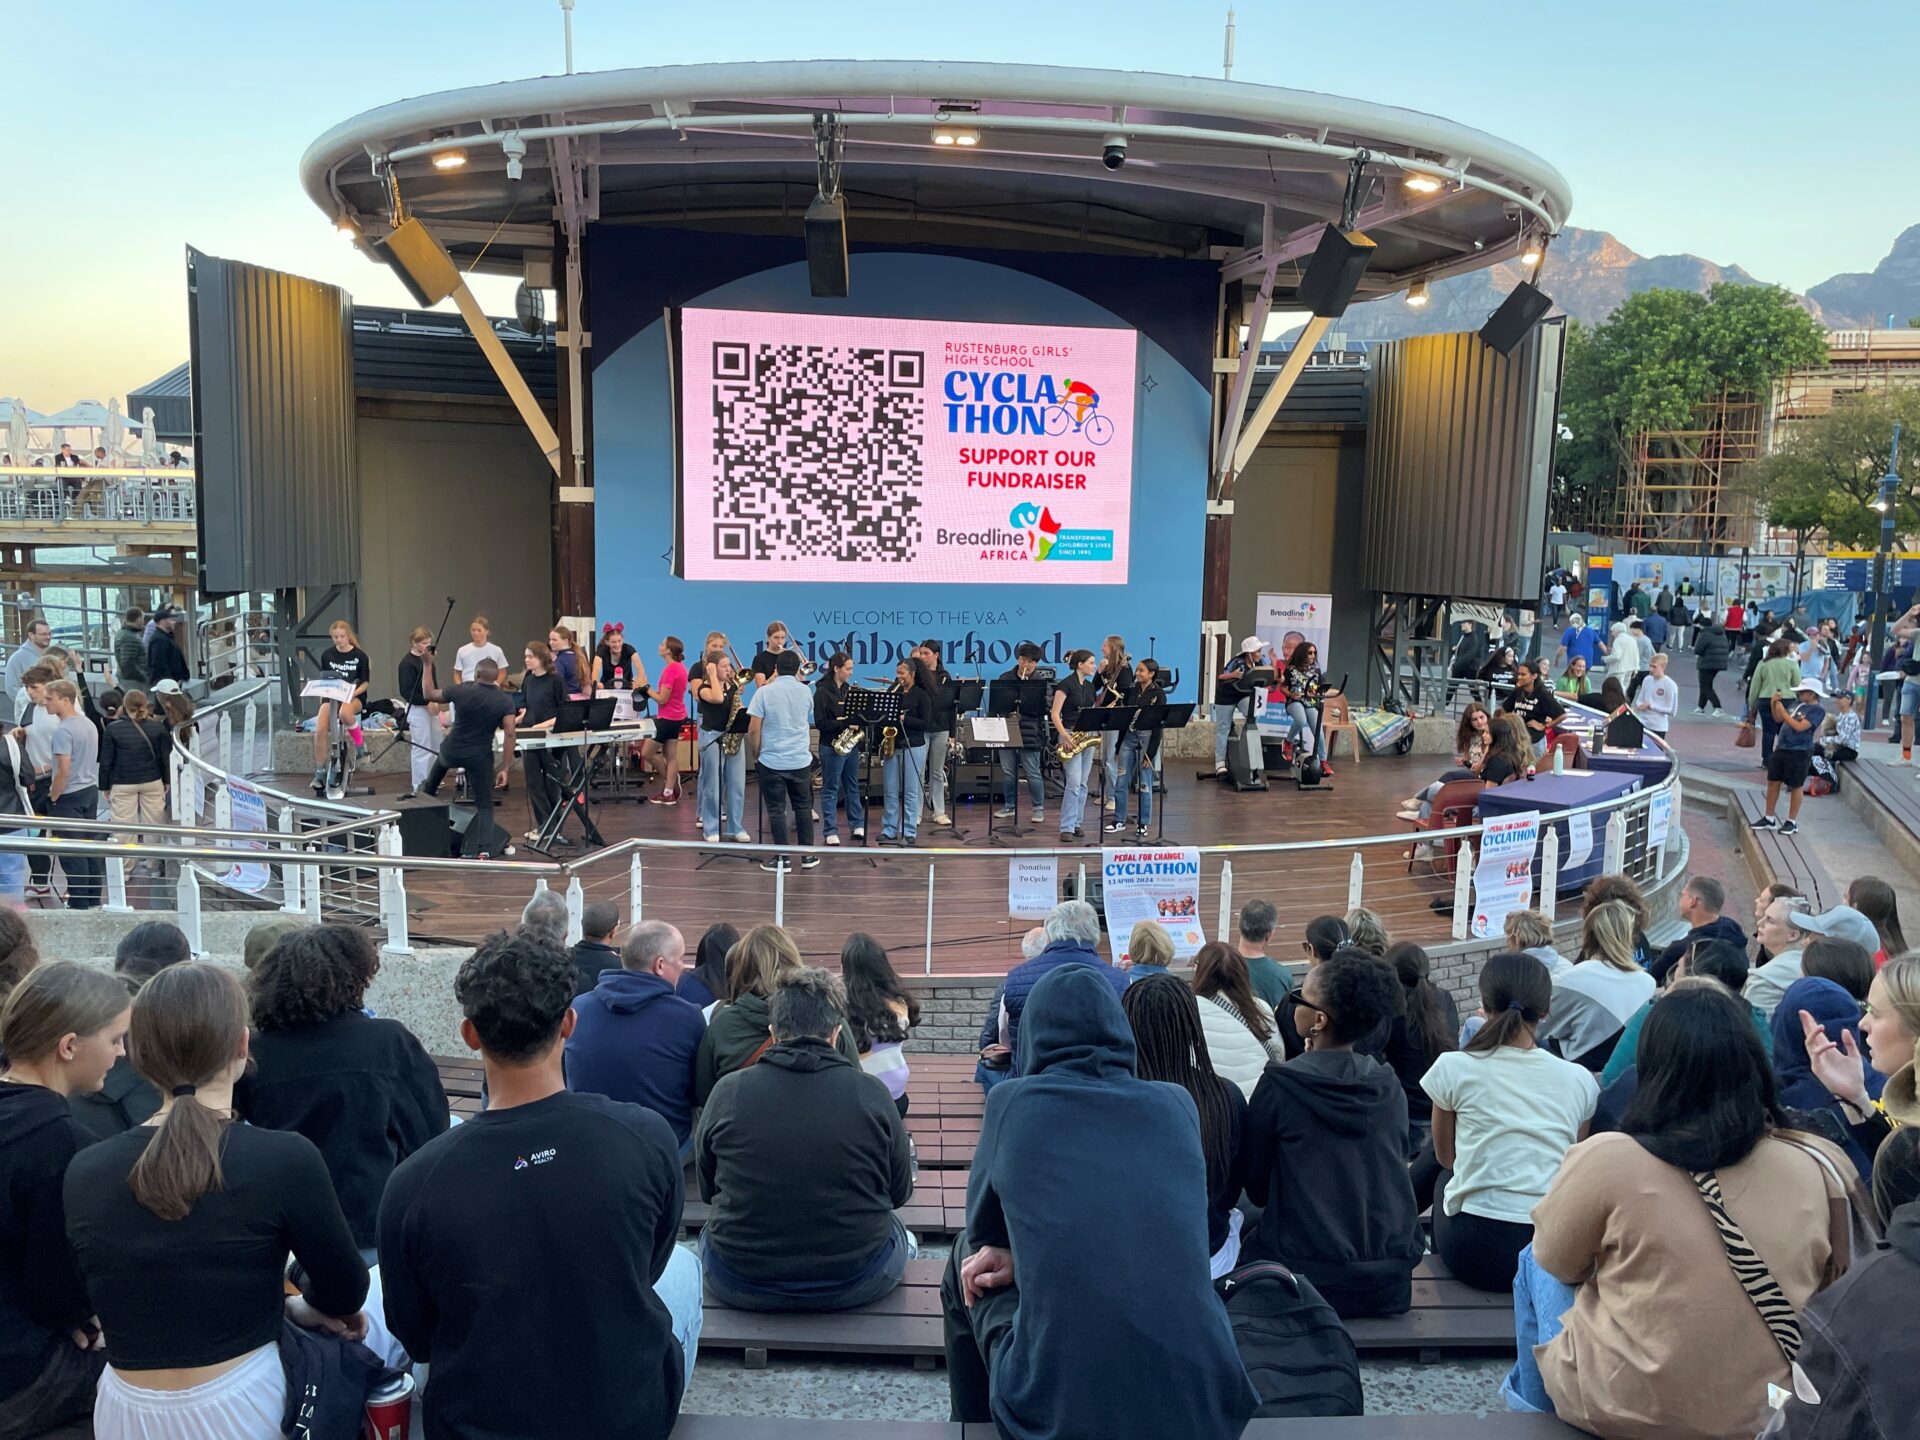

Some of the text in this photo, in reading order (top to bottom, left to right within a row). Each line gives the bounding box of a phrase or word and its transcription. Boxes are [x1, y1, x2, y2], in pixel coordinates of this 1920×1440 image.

[945, 342, 1073, 357] RUSTENBURG GIRLS'
[945, 354, 1035, 367] HIGH SCHOOL
[944, 370, 1058, 404] CYCLA
[943, 403, 1046, 435] THON
[959, 448, 1096, 467] SUPPORT OUR
[967, 471, 1087, 489] FUNDRAISER
[936, 528, 1025, 546] Breadline
[980, 550, 1028, 561] AFRICA
[813, 610, 1009, 625] WELCOME TO THE V&A
[1270, 608, 1305, 617] Breadline
[754, 630, 1063, 675] ighborhood
[1482, 827, 1537, 847] CYCLATHON
[1113, 851, 1185, 862] PEDAL FOR CHANGE!
[1018, 863, 1051, 871] Donation
[1105, 861, 1198, 877] CYCLATHON
[1019, 875, 1049, 884] To Cycle
[530, 1148, 557, 1161] AVIRO
